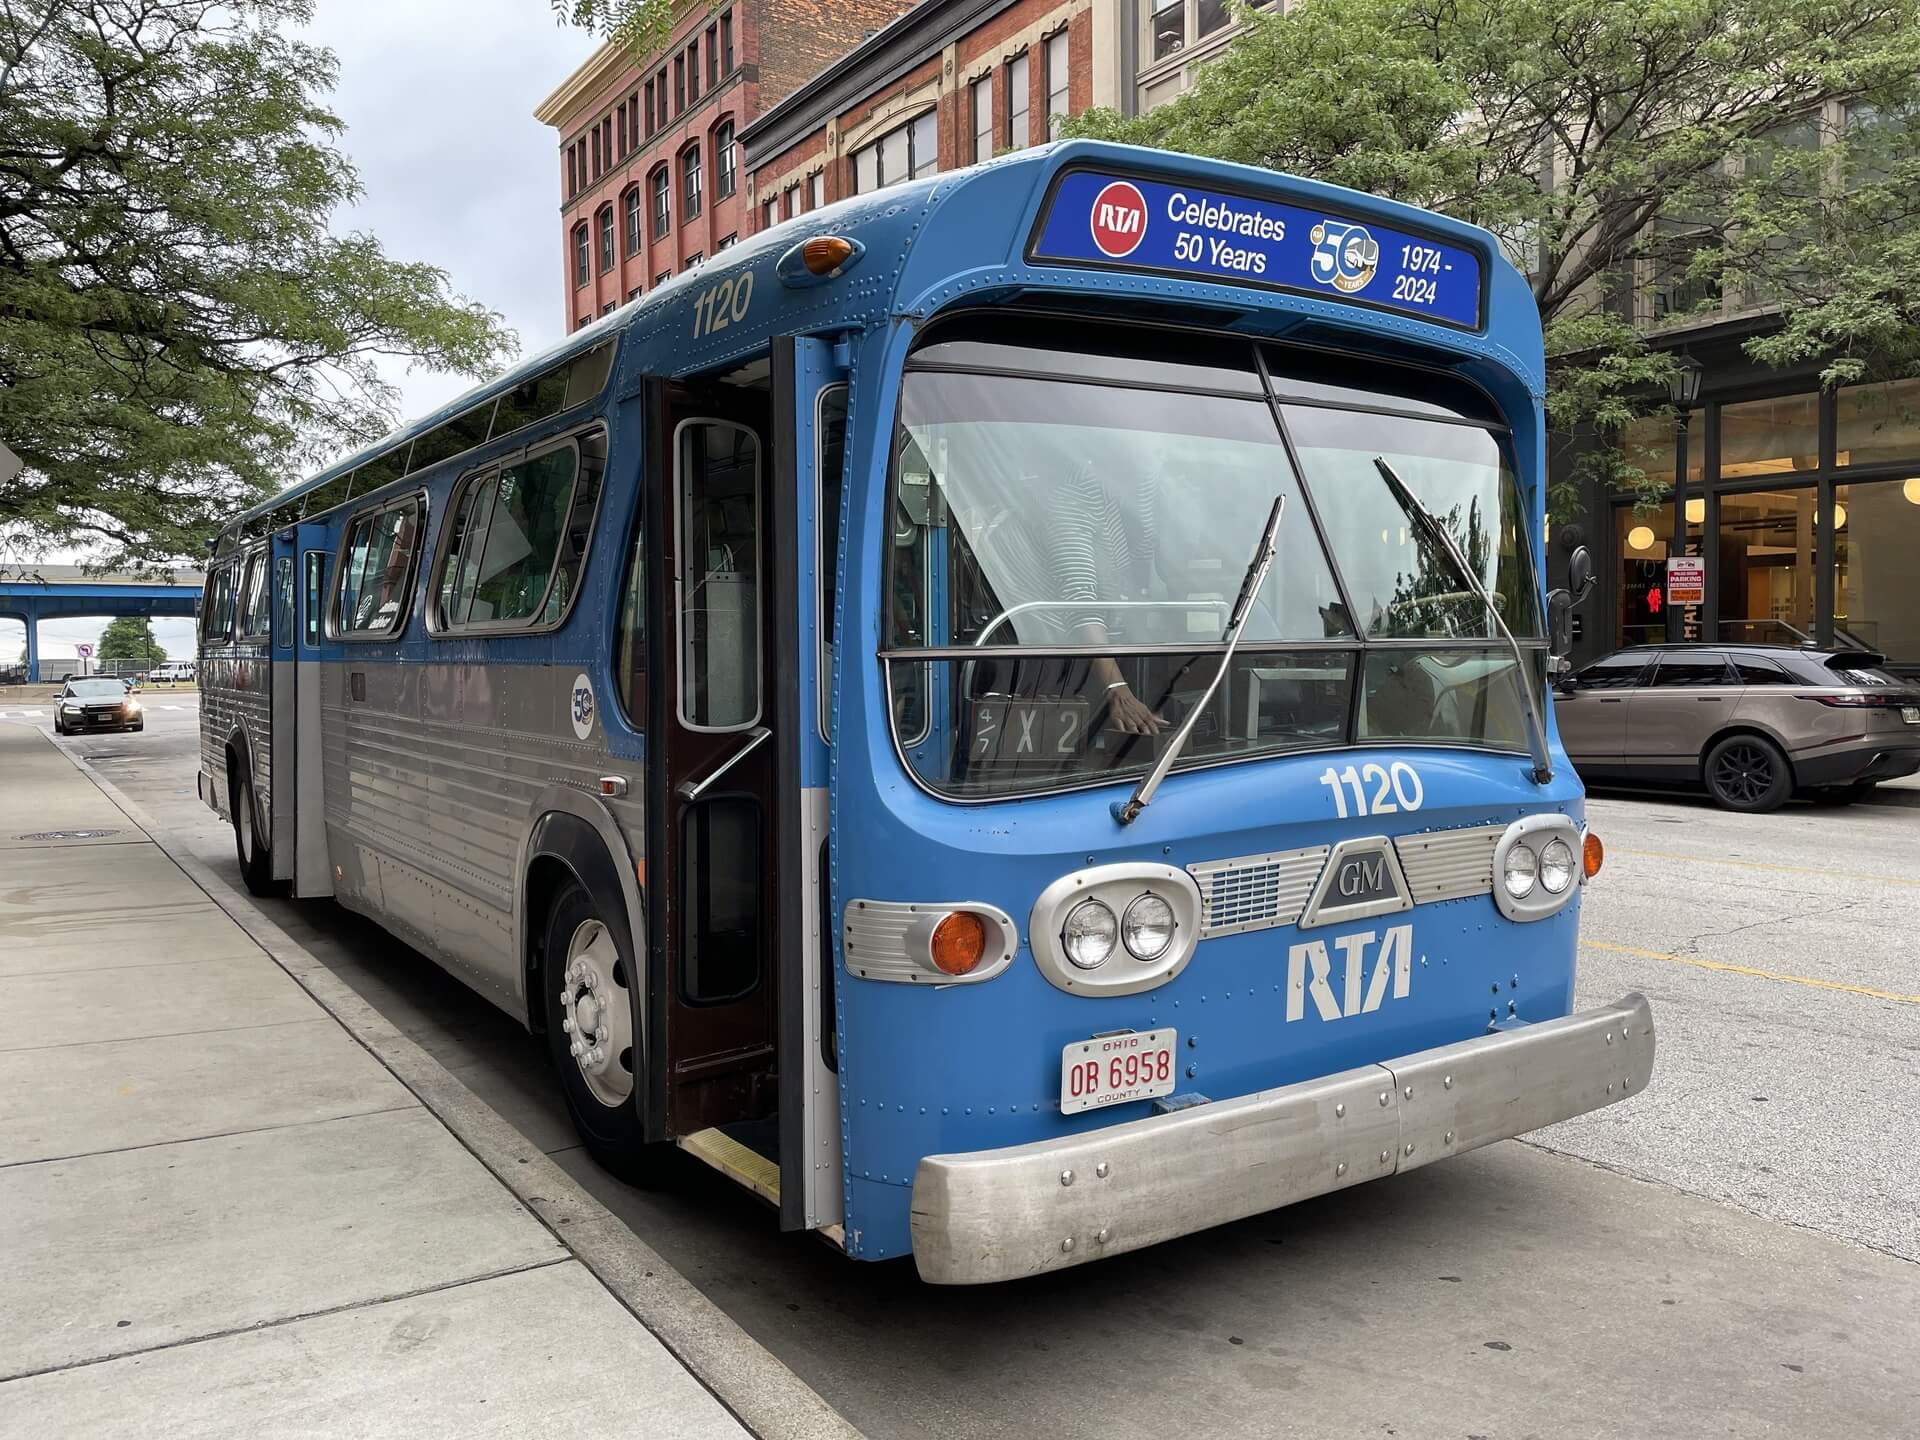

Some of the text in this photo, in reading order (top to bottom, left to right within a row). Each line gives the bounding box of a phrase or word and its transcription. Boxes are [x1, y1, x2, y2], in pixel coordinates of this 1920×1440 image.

[1099, 203, 1140, 233] RTA
[1167, 192, 1285, 241] Celebrates
[1174, 232, 1267, 274] 50 Years
[693, 270, 754, 339] 1120
[1392, 274, 1437, 304] 2024
[1016, 709, 1037, 753] X
[1057, 710, 1079, 753] 2
[1319, 761, 1424, 819] 1120
[1338, 857, 1385, 897] GM
[1286, 924, 1413, 1023] RTA
[1103, 1039, 1138, 1051] OHIO
[1109, 1049, 1170, 1089] 6958
[1097, 1088, 1141, 1104] COUNTY
